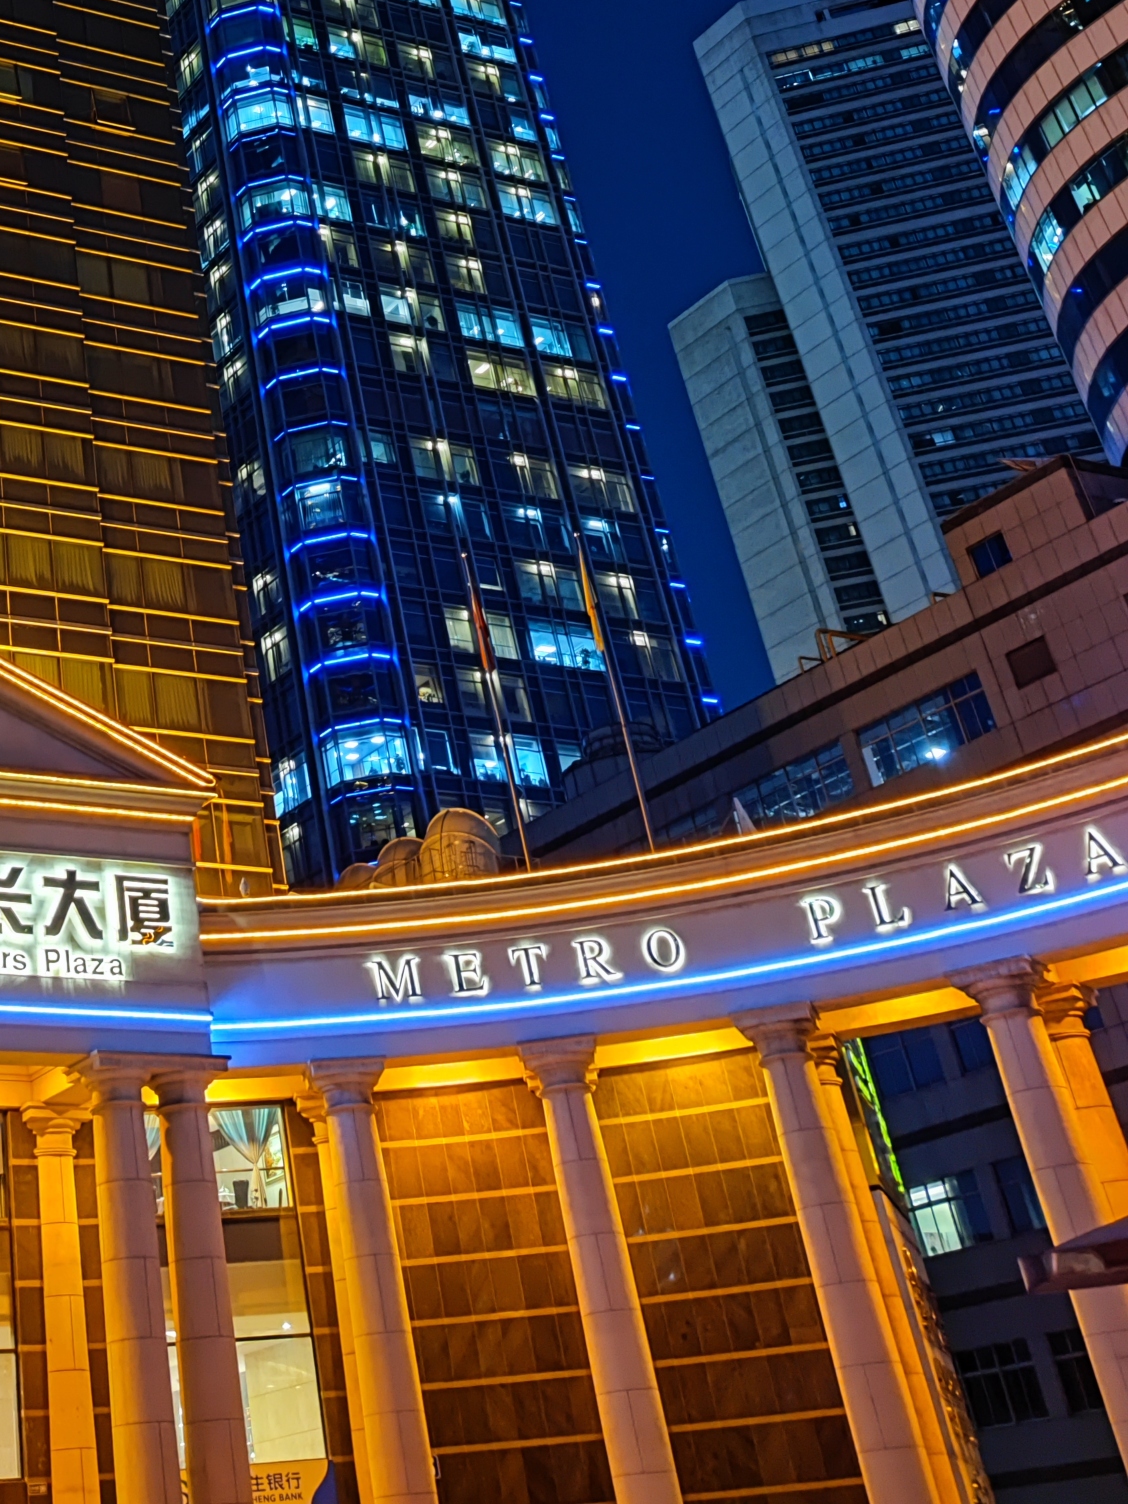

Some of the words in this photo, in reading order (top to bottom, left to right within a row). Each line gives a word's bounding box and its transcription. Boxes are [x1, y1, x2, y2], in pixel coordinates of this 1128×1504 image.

[371, 929, 682, 1001] METRO
[801, 827, 1127, 940] PLAZA
[44, 948, 125, 977] Plaza
[279, 1492, 303, 1501] BANK
